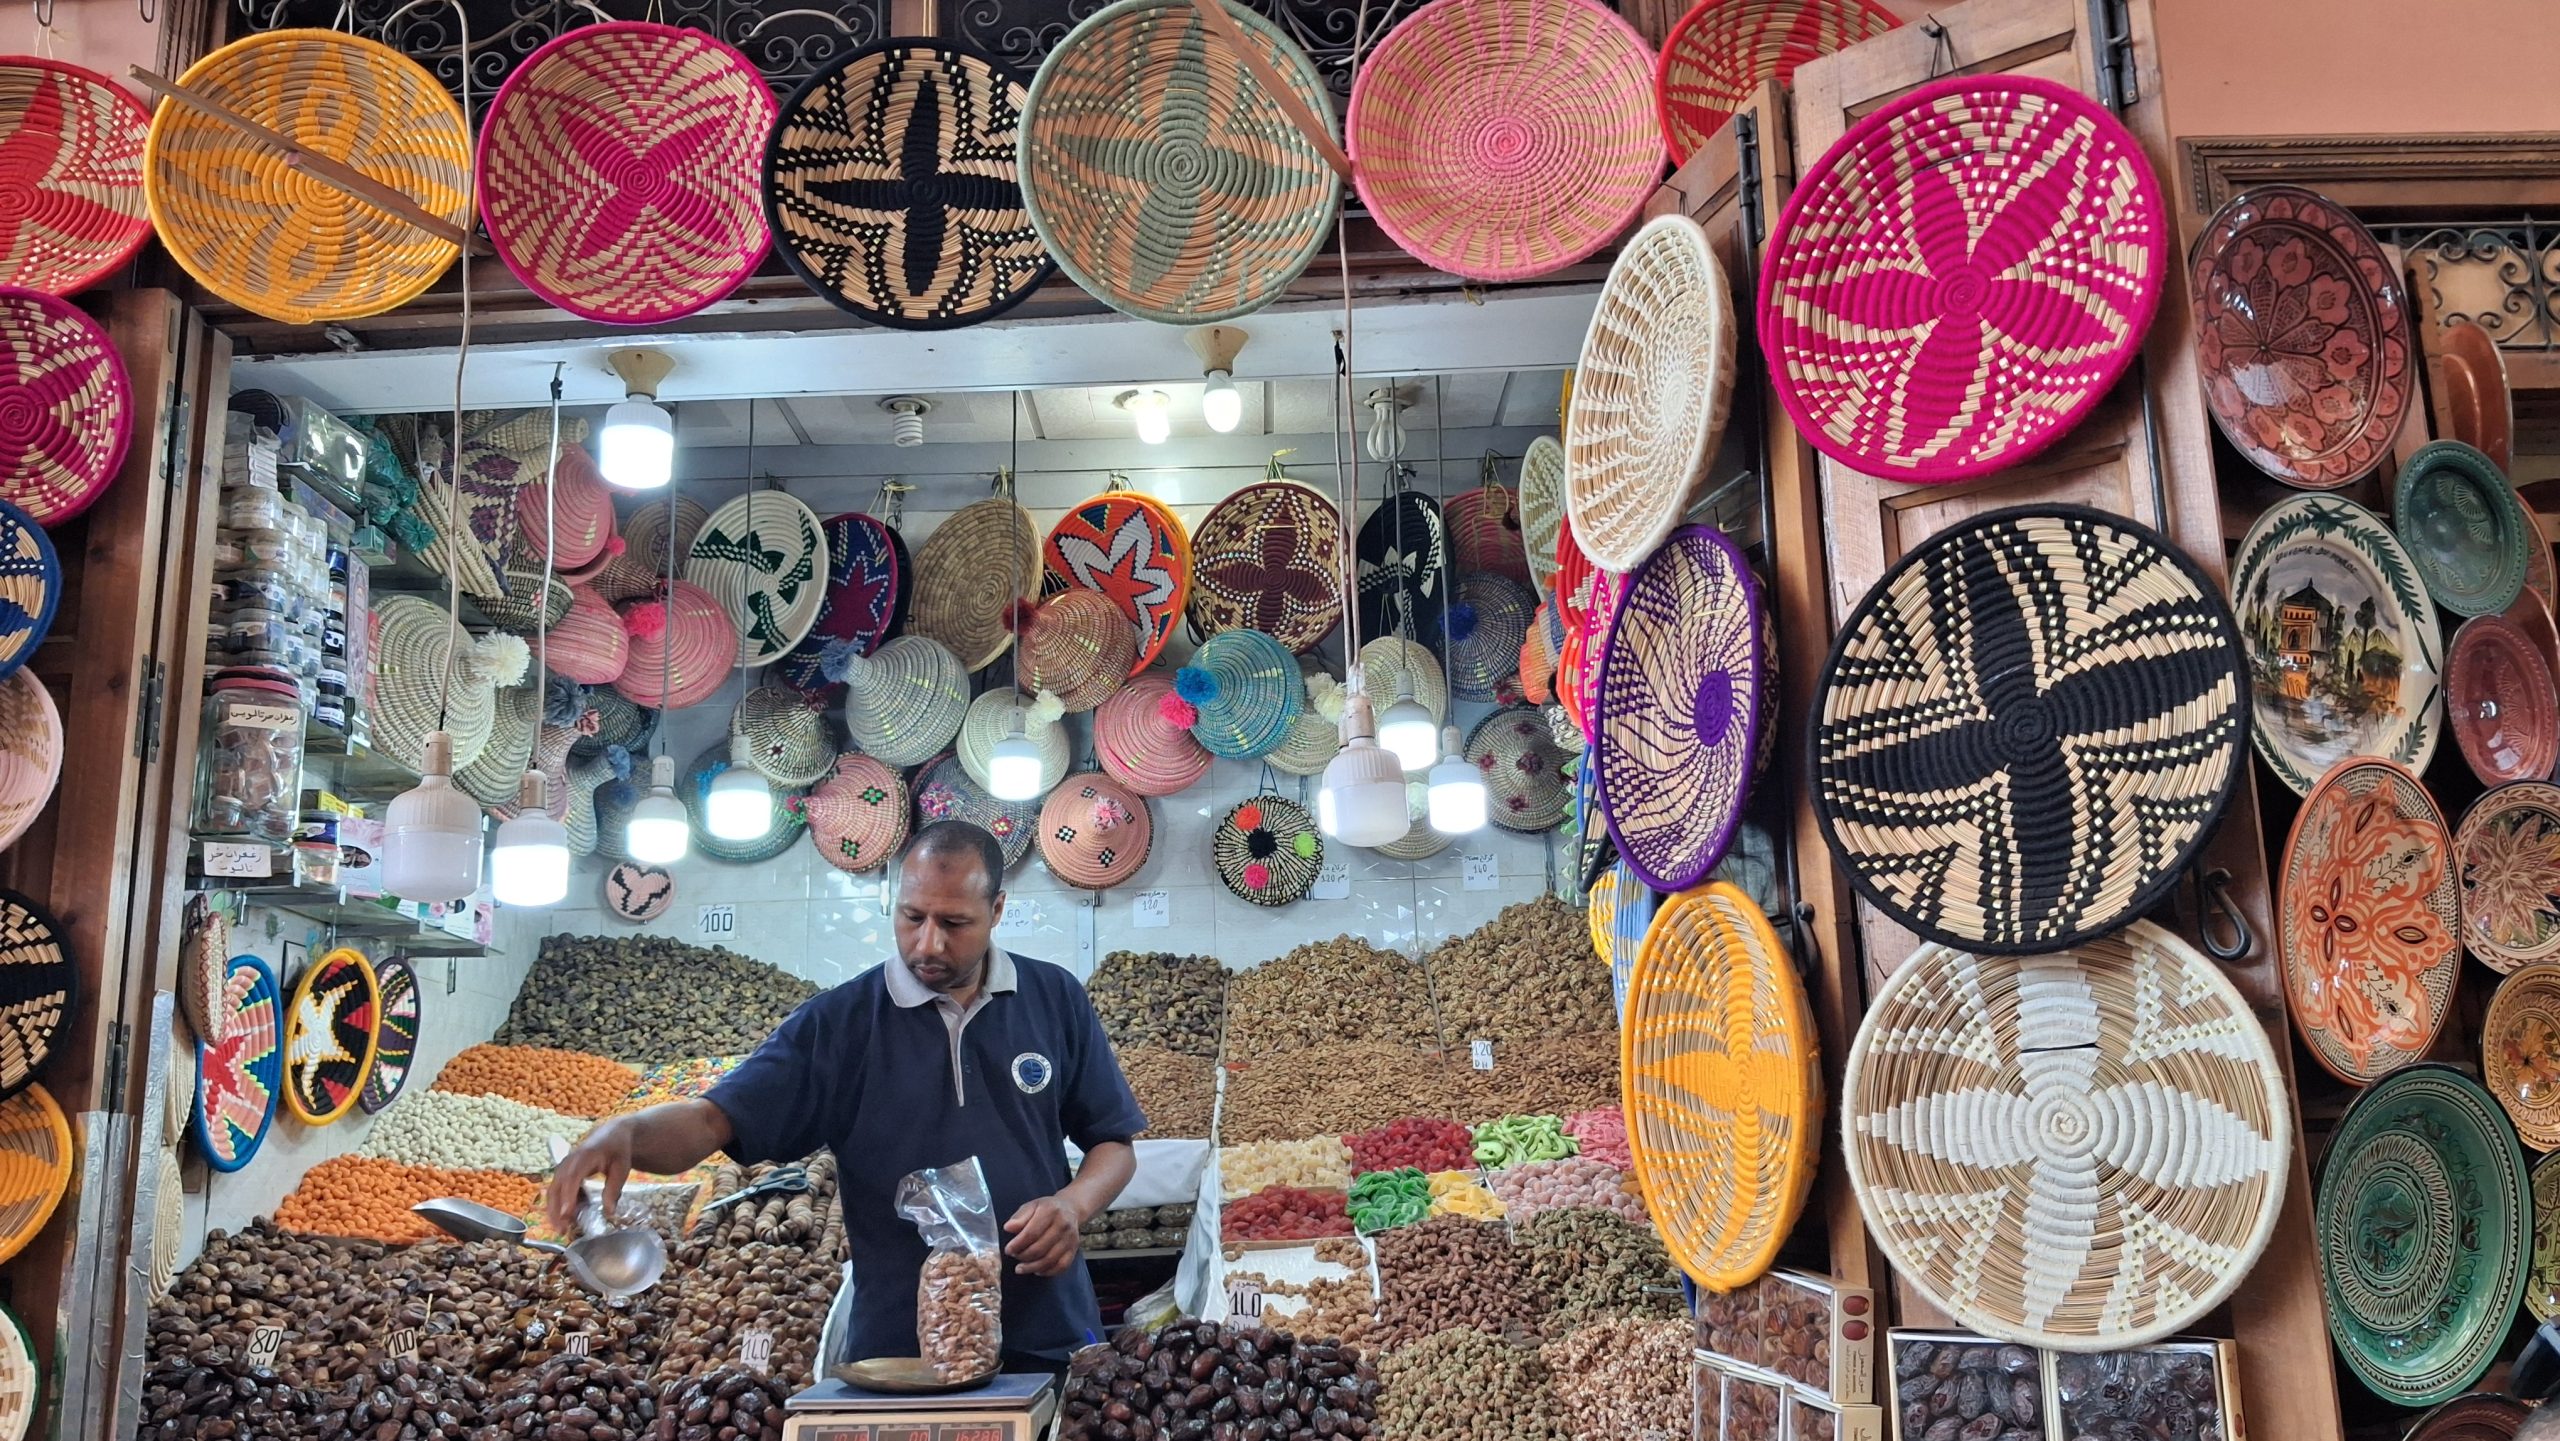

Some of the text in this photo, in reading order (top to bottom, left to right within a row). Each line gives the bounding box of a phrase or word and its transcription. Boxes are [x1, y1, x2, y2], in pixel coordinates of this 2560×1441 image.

[1321, 874, 1336, 883] 120
[1473, 863, 1488, 874] 140
[1142, 899, 1159, 911] 120
[700, 913, 733, 933] 100
[1473, 1041, 1492, 1057] 120
[1230, 1290, 1261, 1318] 140
[250, 1328, 280, 1354] 80
[388, 1329, 416, 1356] 100
[741, 1338, 770, 1361] 140
